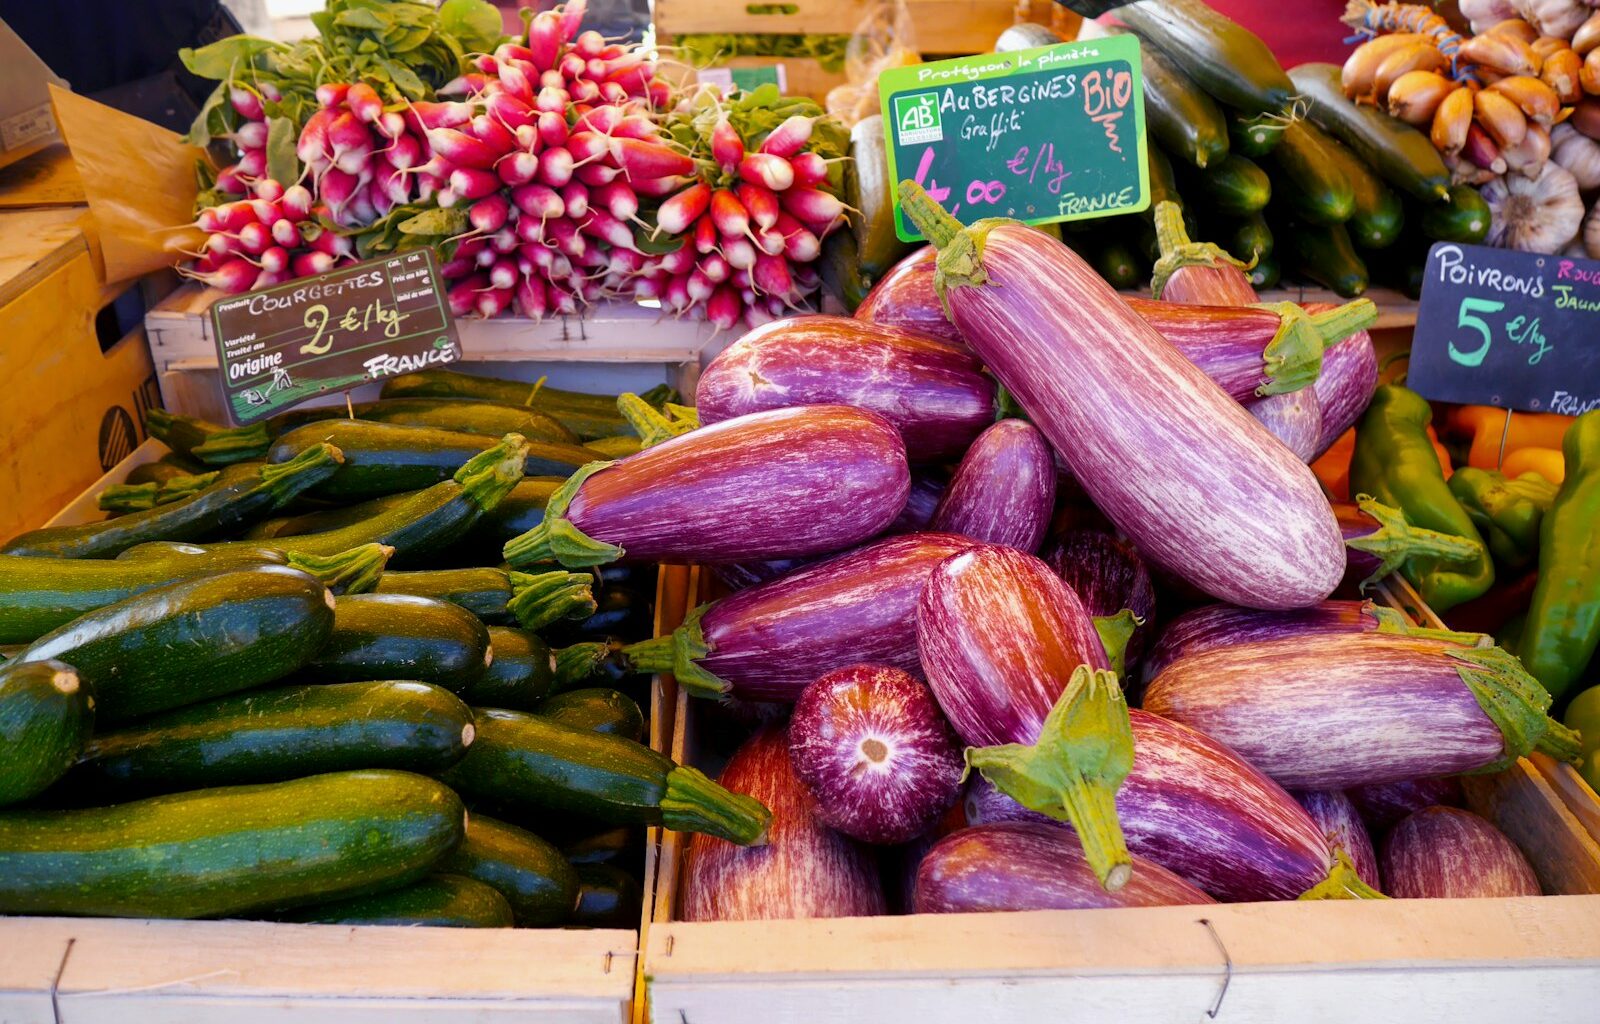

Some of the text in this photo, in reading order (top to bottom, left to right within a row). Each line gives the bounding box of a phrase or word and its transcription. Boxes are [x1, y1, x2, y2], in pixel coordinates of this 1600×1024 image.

[1018, 55, 1032, 68] la
[1037, 46, 1100, 69] planète
[901, 105, 935, 131] AB
[1058, 186, 1134, 216] FRANCE
[219, 298, 250, 312] Produit
[249, 271, 384, 315] COURGETTES
[224, 332, 256, 347] Variété
[300, 304, 334, 354] 2
[1448, 297, 1505, 367] 5
[226, 341, 265, 358] Traité au
[363, 341, 455, 379] FRANCE
[229, 352, 283, 379] Origine
